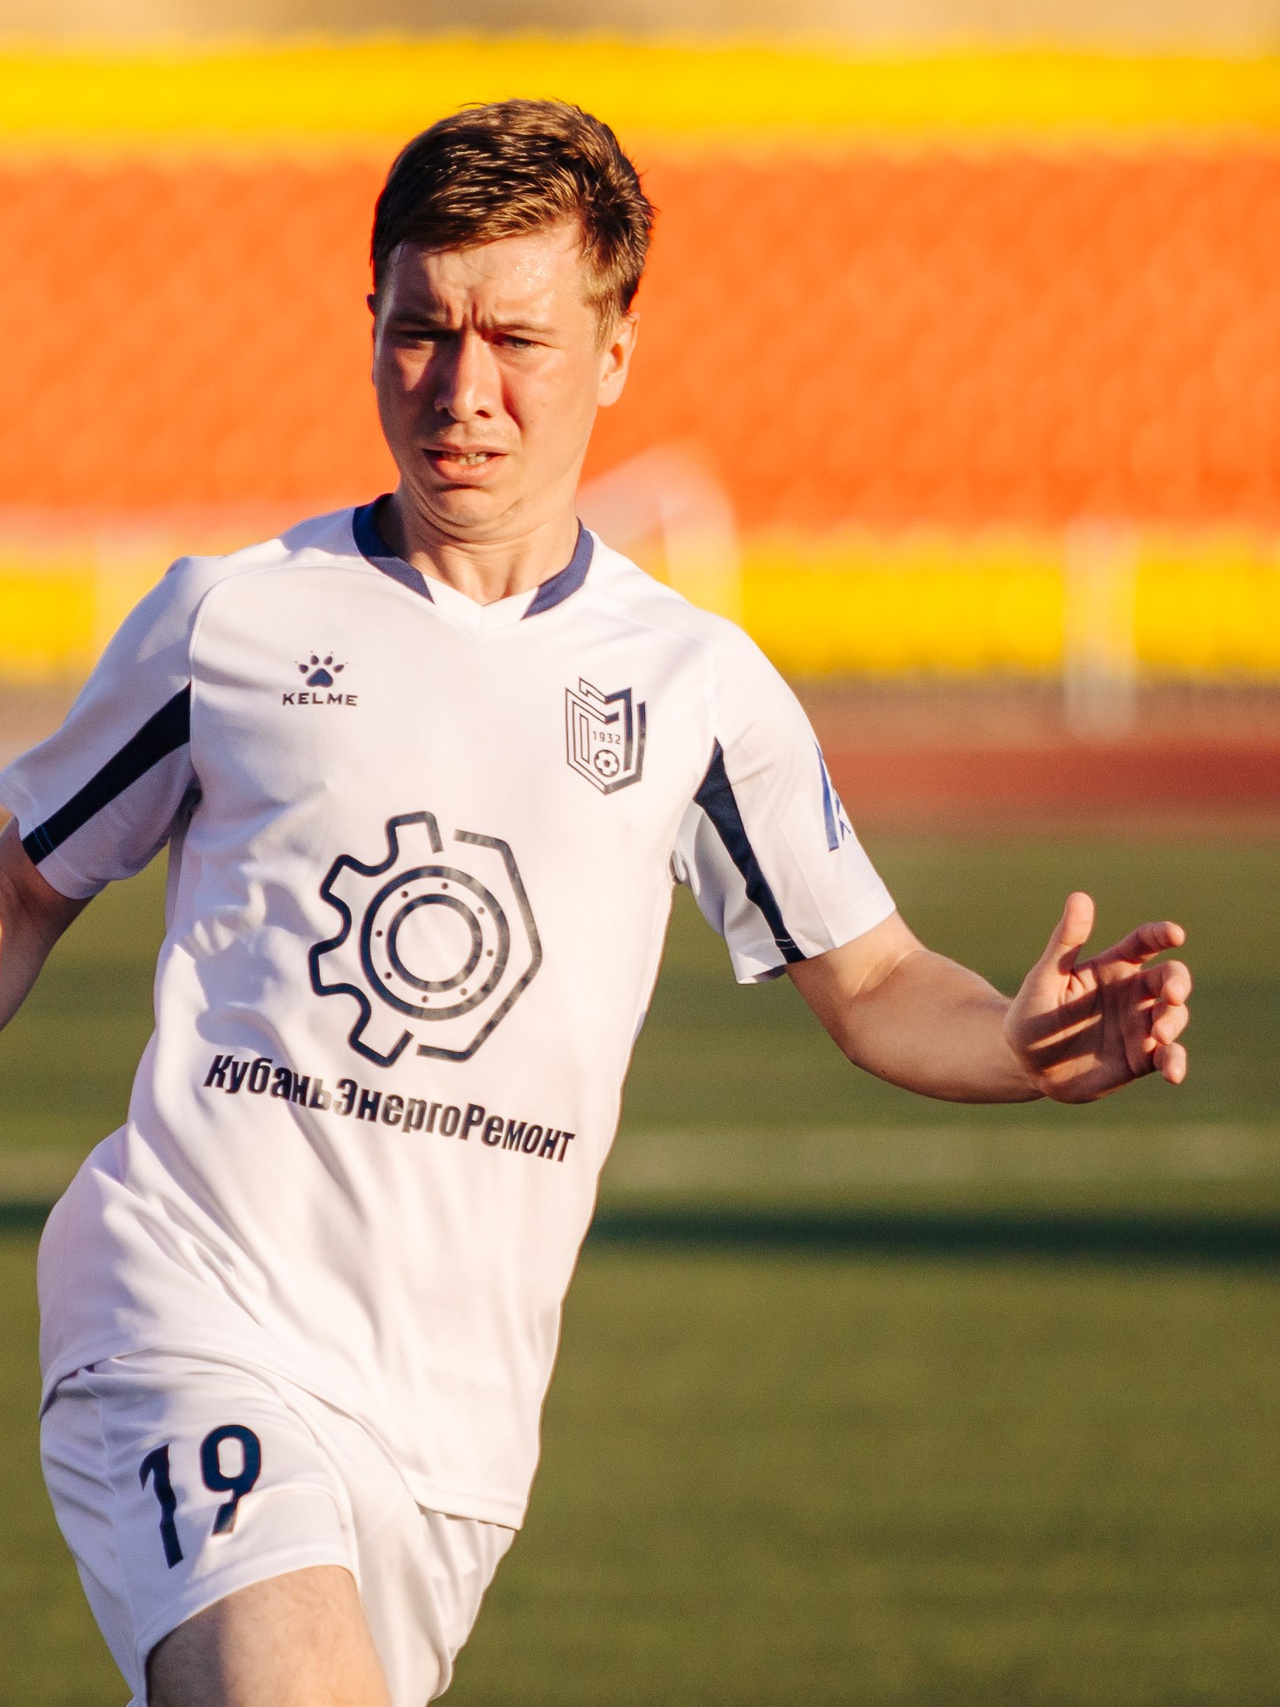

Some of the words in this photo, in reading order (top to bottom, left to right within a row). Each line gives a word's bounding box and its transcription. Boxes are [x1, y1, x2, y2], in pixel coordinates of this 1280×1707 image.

[282, 692, 358, 706] KELME
[592, 730, 621, 745] 1932
[203, 1054, 576, 1163] КубаньЭнергоРемонт
[138, 1424, 262, 1570] 19
